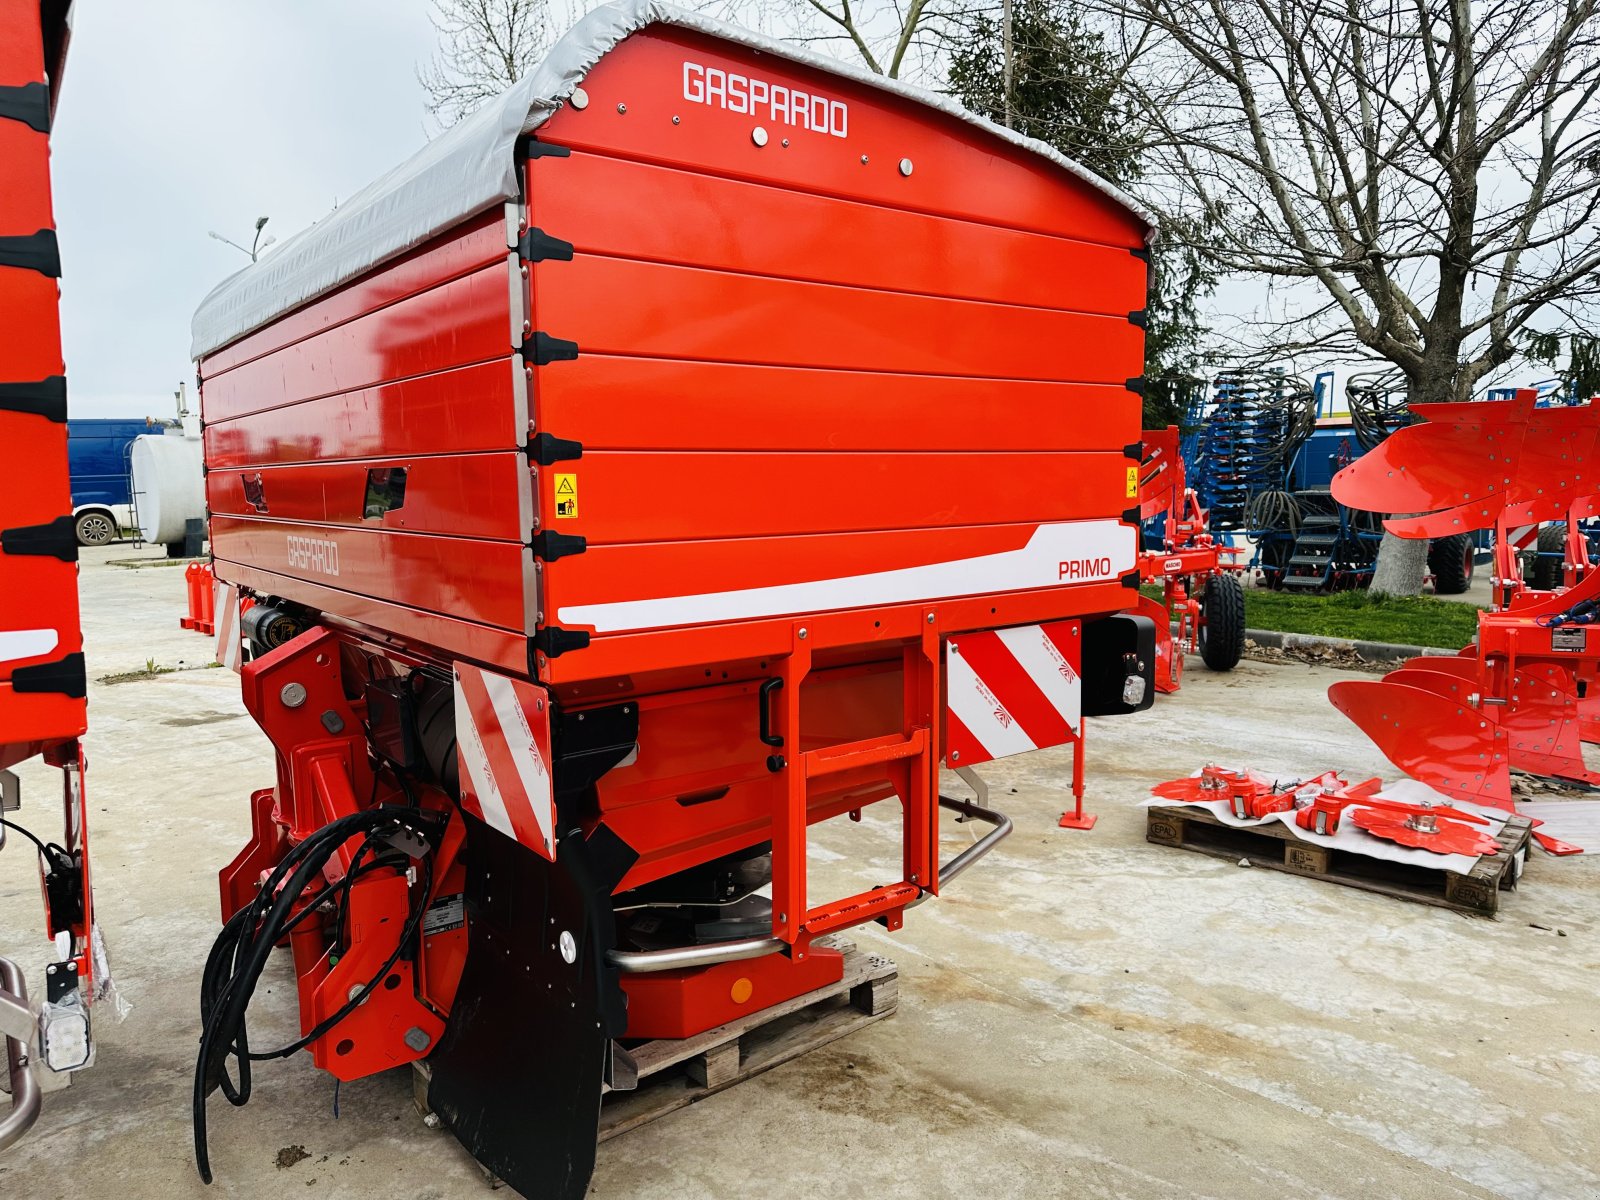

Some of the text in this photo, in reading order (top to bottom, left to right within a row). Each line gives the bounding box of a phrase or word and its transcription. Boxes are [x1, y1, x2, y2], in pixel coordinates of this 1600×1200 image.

[683, 61, 848, 138] GASPARDO
[287, 535, 340, 577] GASPARDO
[1059, 557, 1111, 580] PRIMO
[1154, 824, 1174, 837] EPAL
